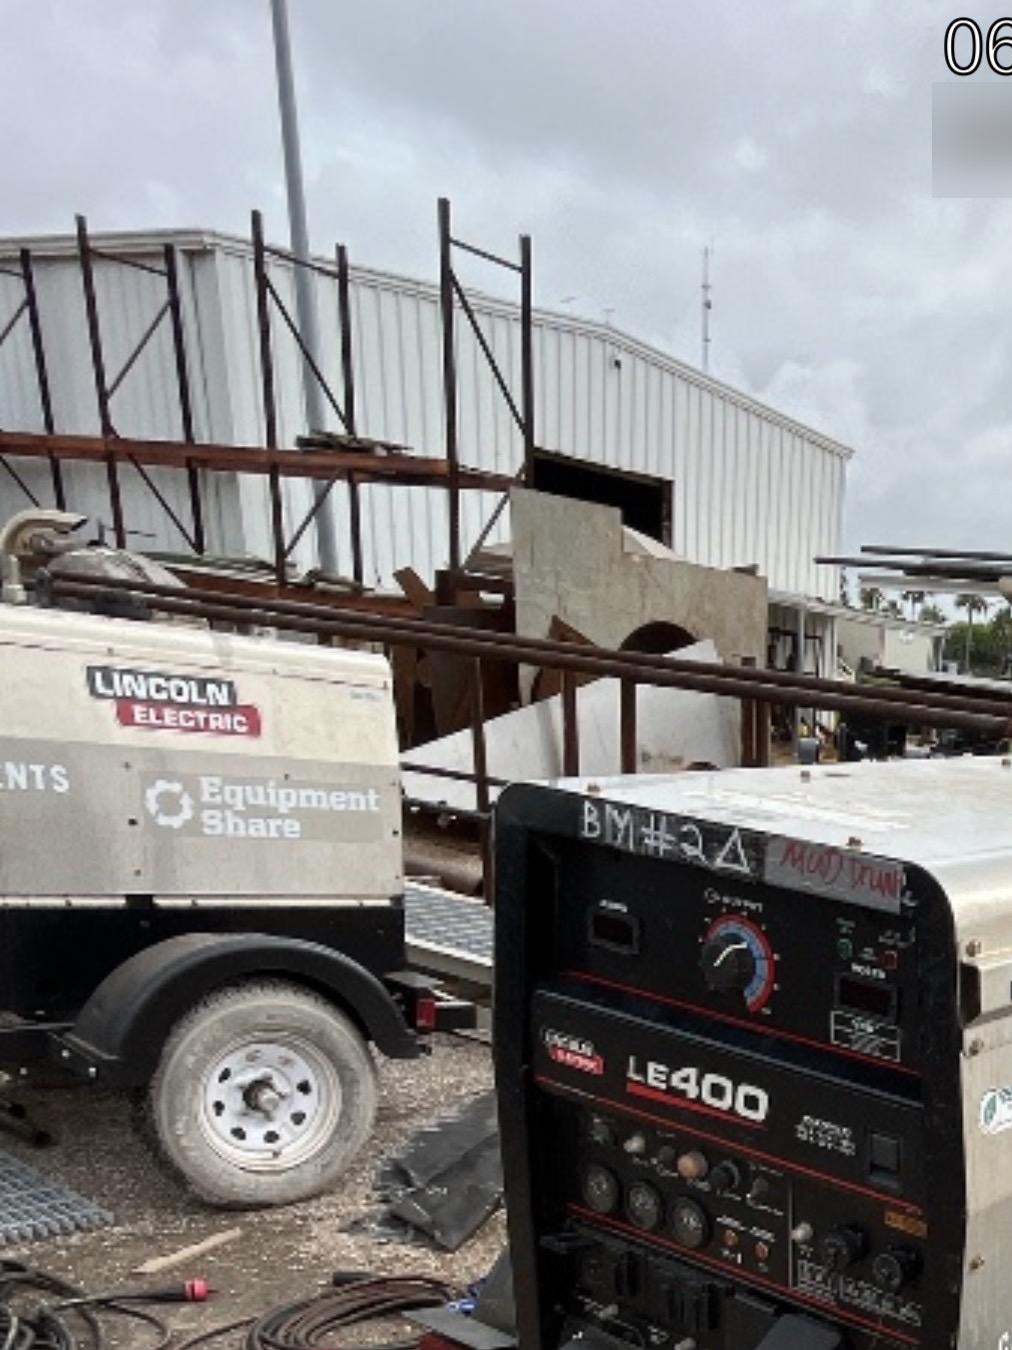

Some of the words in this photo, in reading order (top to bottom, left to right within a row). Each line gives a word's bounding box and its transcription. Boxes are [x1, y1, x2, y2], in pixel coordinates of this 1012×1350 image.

[94, 671, 231, 706] LINCOLN
[132, 704, 250, 734] ELECTRIC
[0, 761, 70, 793] NTS
[200, 776, 381, 813] Equipment
[202, 810, 301, 839] Share
[627, 1055, 769, 1122] LE400
